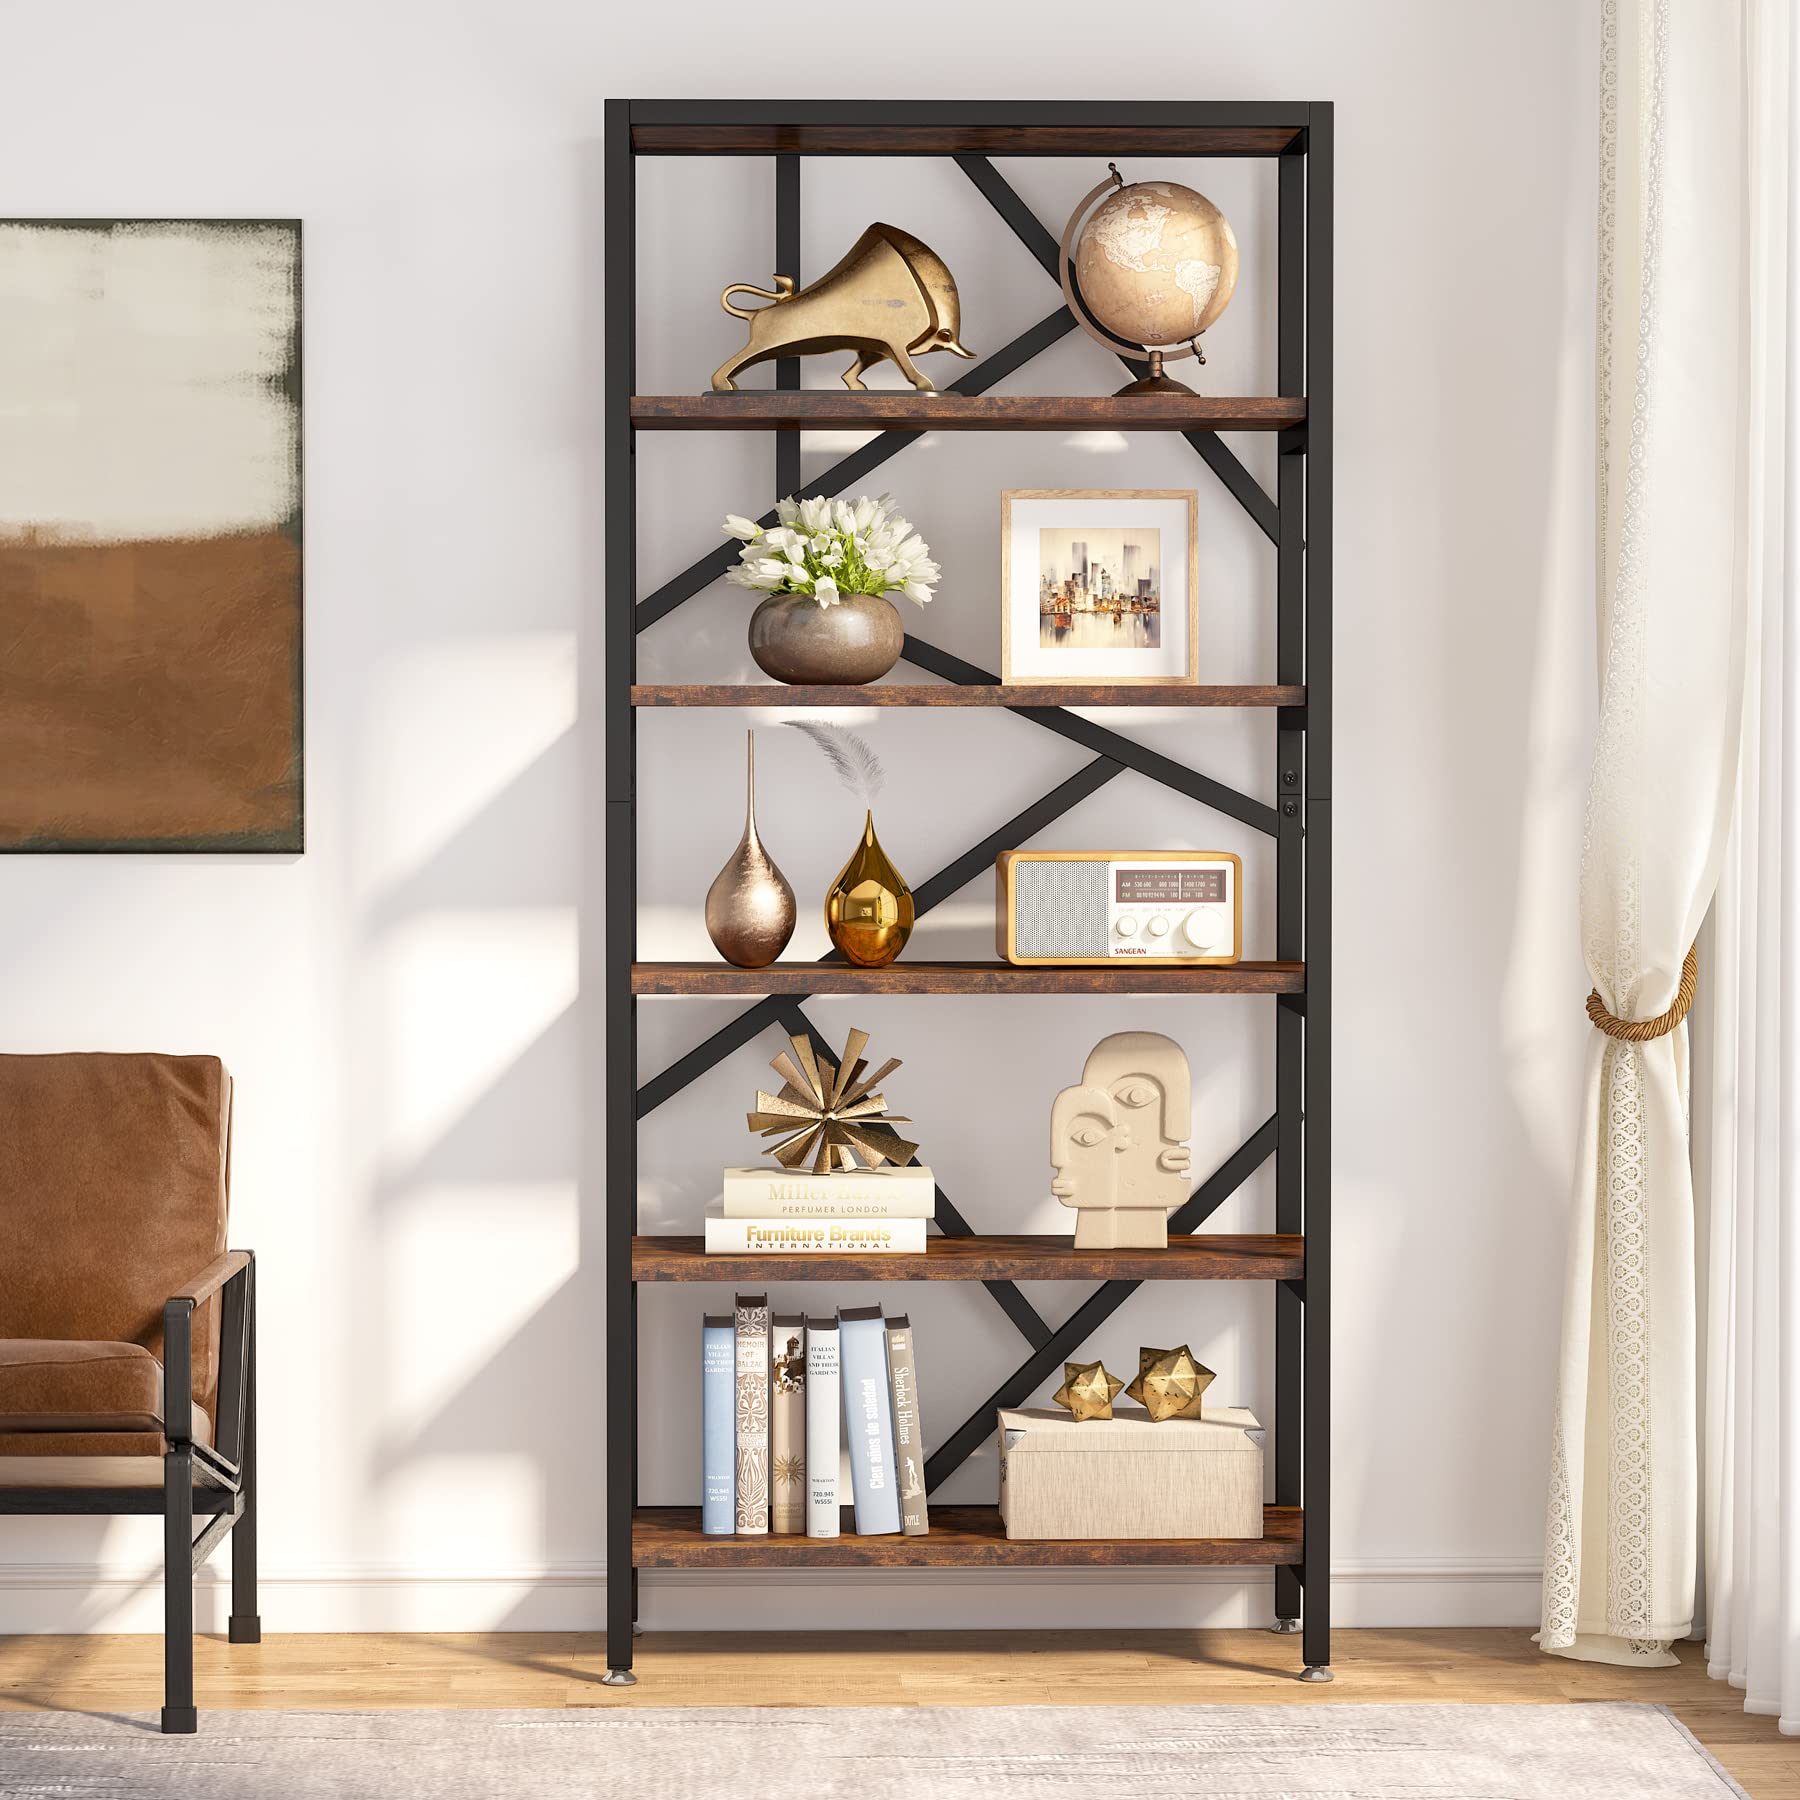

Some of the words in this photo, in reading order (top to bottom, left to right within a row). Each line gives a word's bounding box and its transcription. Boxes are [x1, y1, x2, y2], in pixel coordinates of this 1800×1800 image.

[746, 1225, 825, 1242] Furniture
[830, 1225, 892, 1242] Brands
[860, 1378, 879, 1420] soledad
[894, 1366, 912, 1408] Sherlock
[865, 1422, 880, 1436] de
[897, 1410, 914, 1445] Holmes
[869, 1466, 885, 1490] Cien
[904, 1514, 921, 1527] DOYLE
